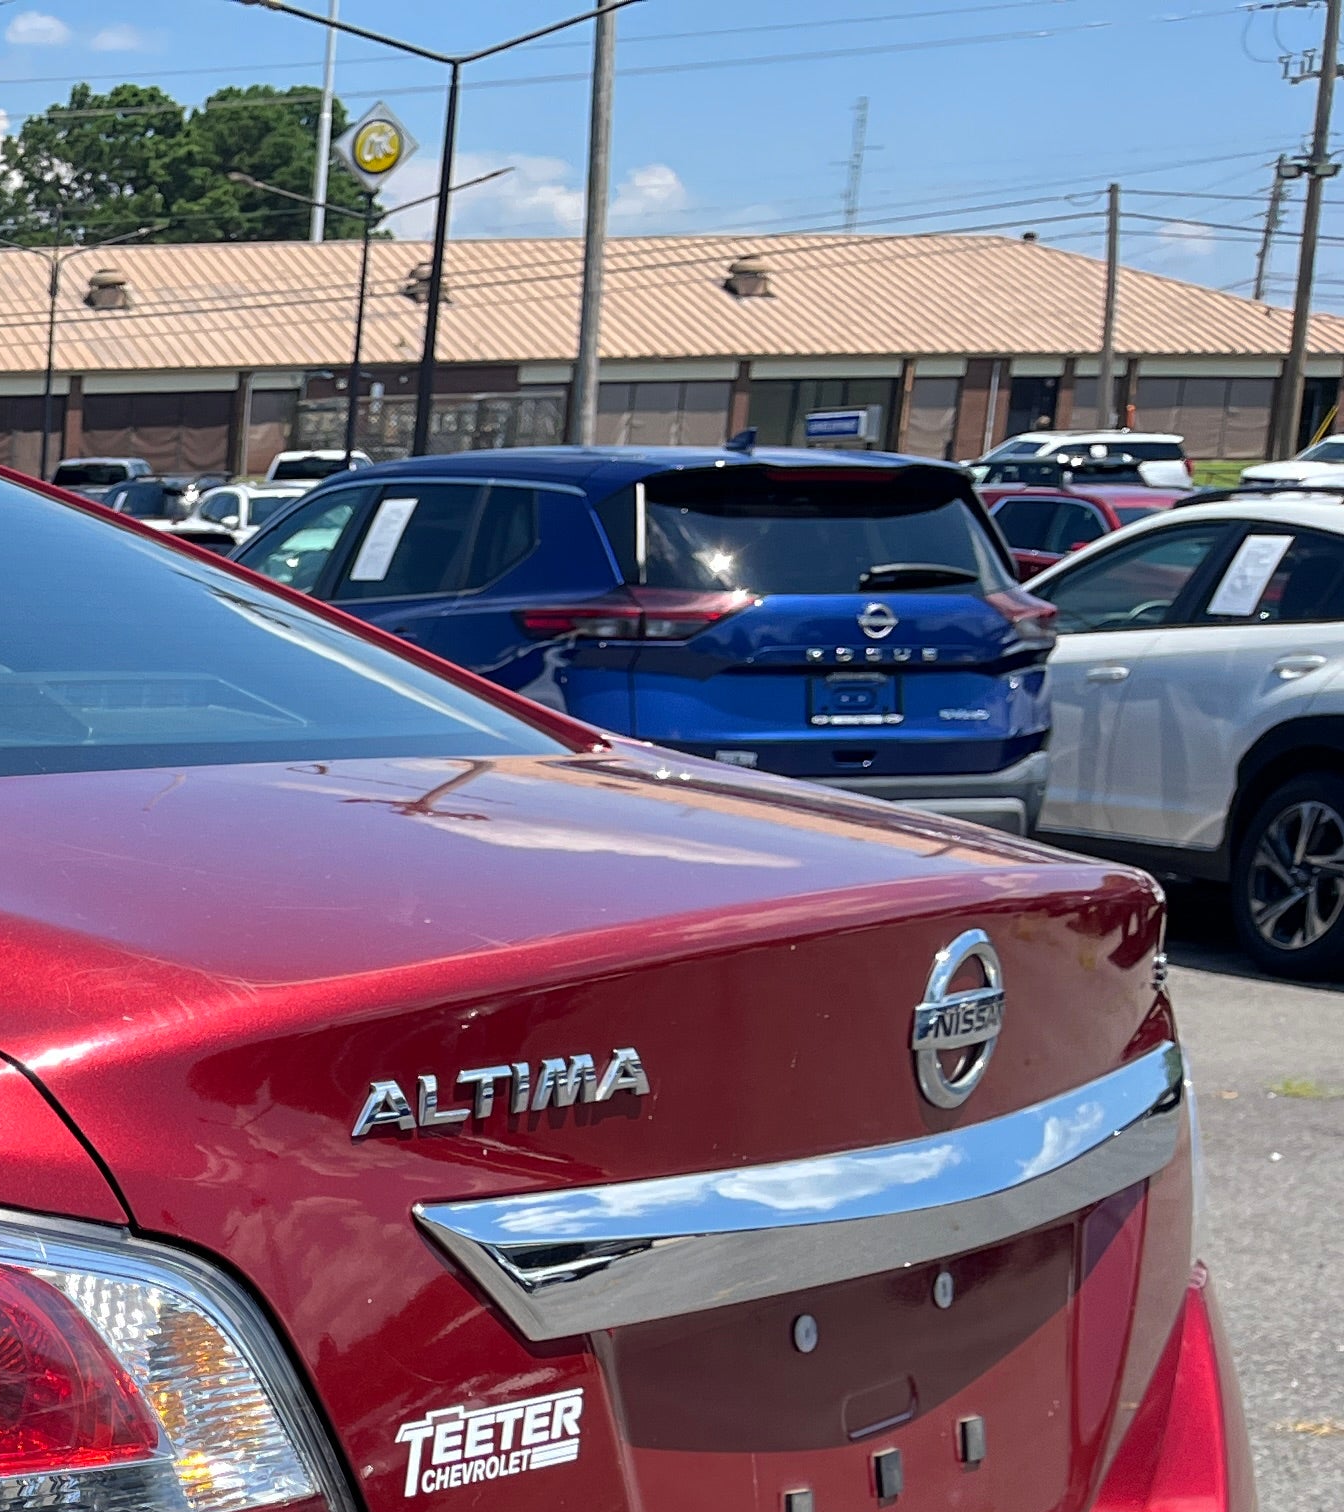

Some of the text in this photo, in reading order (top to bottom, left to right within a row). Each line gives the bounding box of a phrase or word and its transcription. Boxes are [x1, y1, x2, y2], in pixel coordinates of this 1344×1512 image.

[352, 1047, 650, 1137] ALTIMA
[396, 1390, 583, 1498] TEETER
[421, 1449, 531, 1494] CHEVROLET
